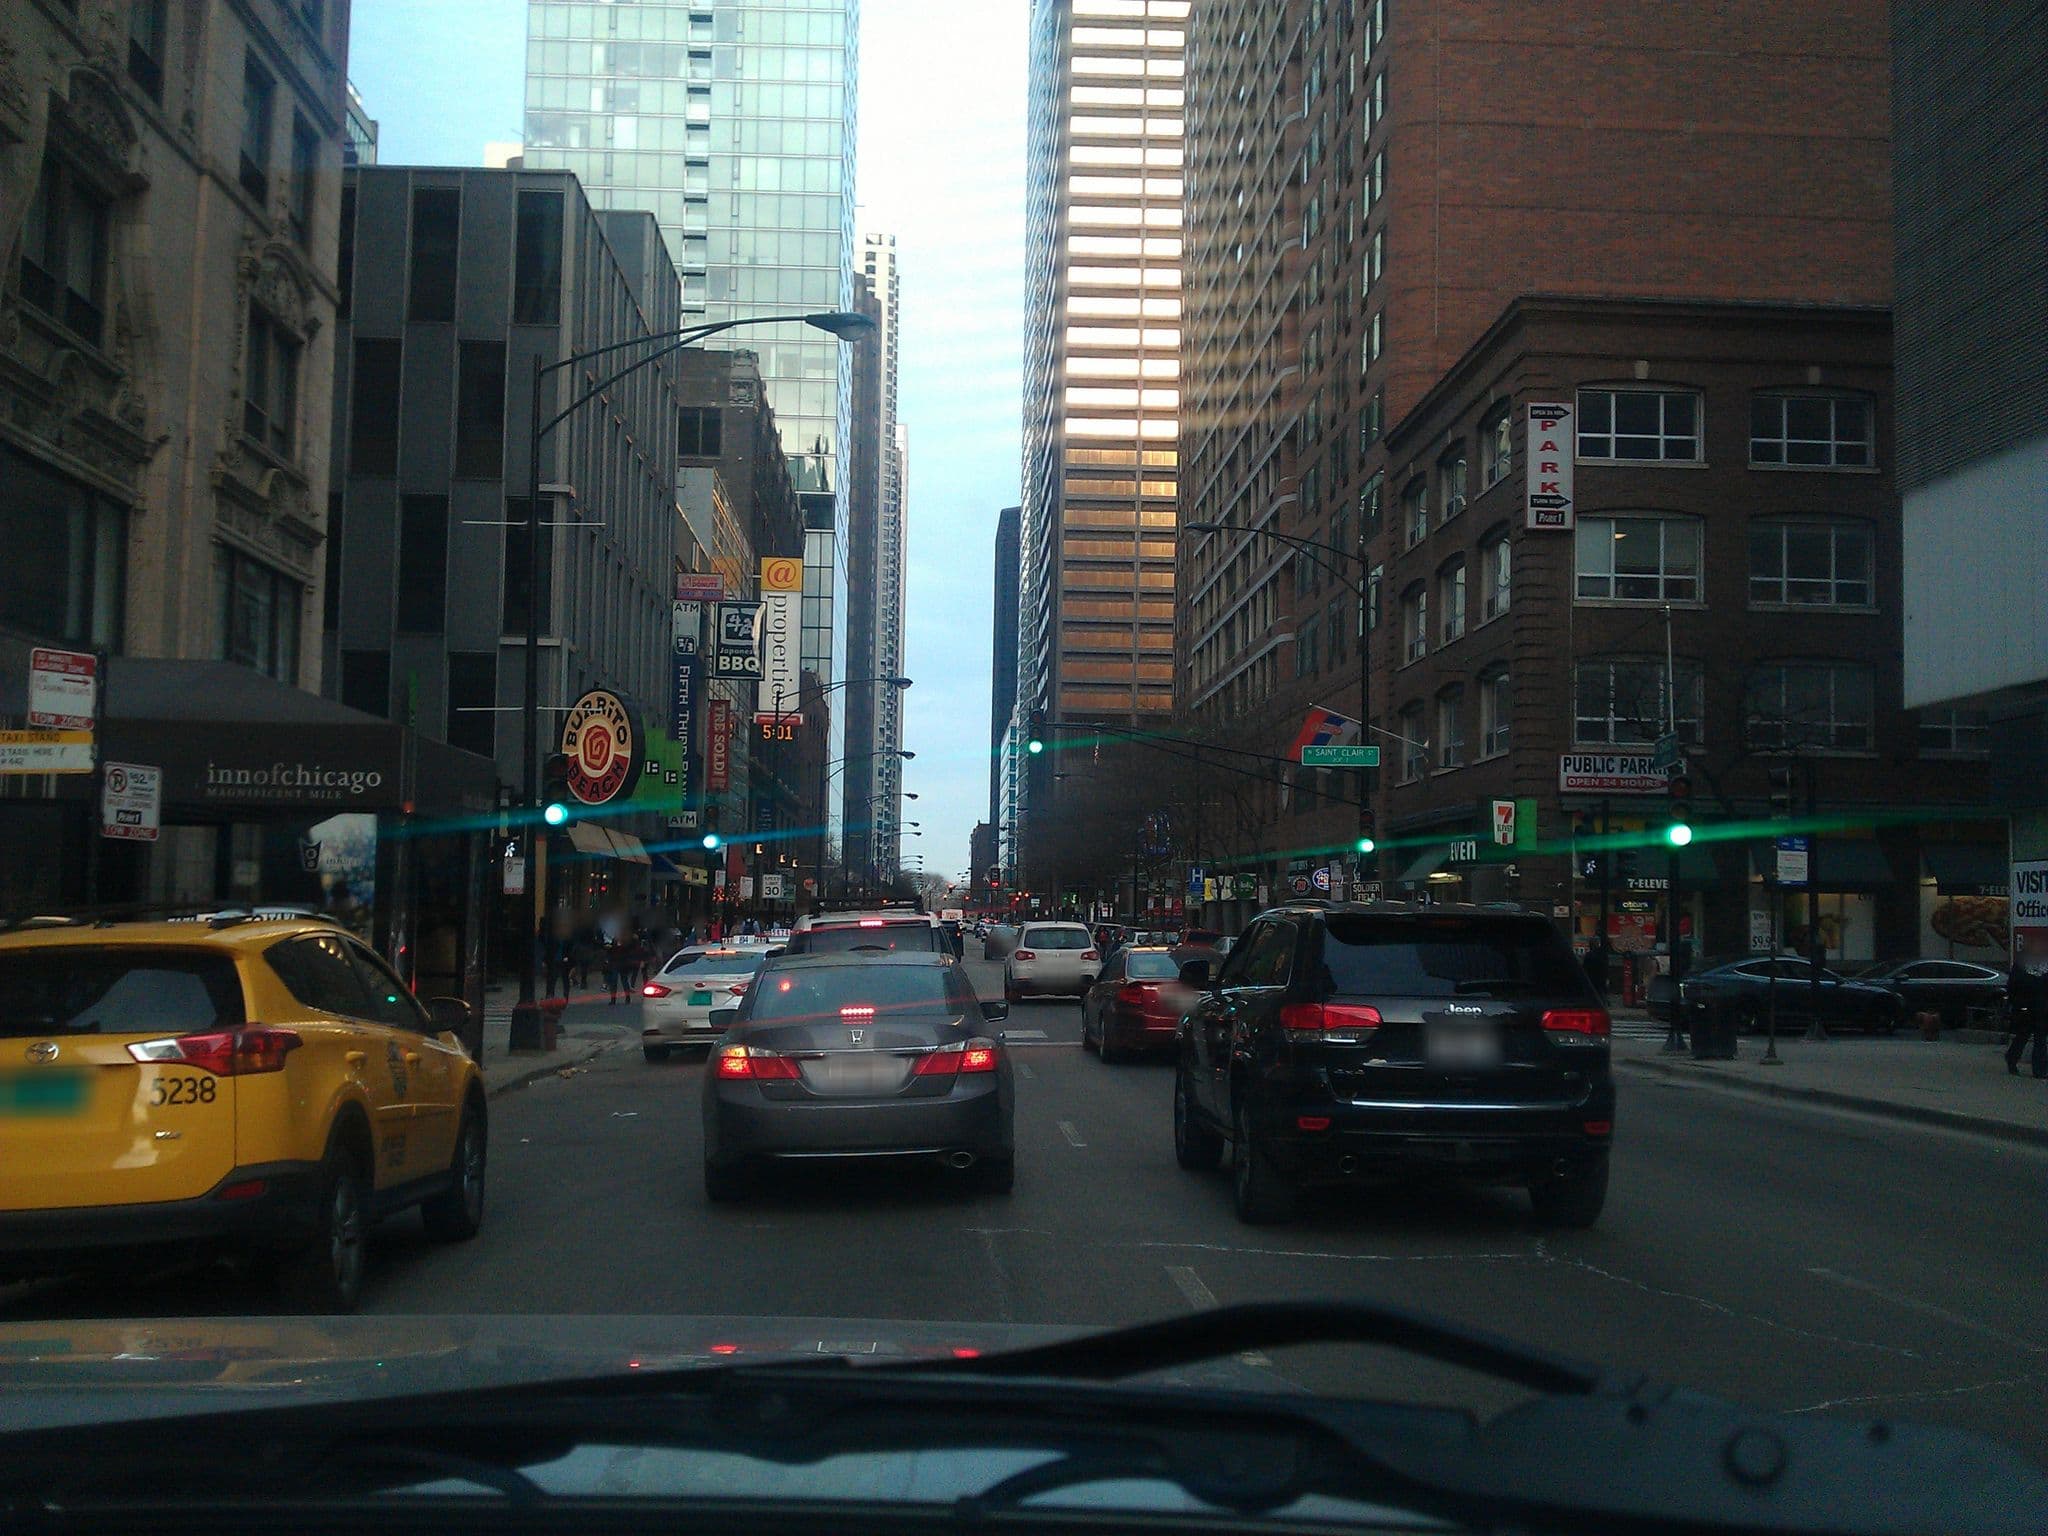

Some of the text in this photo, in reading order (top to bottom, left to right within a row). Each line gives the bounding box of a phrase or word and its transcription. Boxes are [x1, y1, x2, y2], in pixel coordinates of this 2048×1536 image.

[1539, 420, 1559, 493] PARK
[767, 559, 797, 589] @
[675, 602, 699, 612] ATM
[719, 655, 761, 672] BBQ
[678, 665, 691, 704] FIFTH
[34, 712, 88, 728] TOW ZONE
[566, 696, 627, 746] BURRITO
[713, 704, 725, 776] TRE SOLDI
[763, 724, 793, 740] 5:01
[1341, 749, 1364, 757] CLAIR
[1563, 757, 1669, 775] PUBLIC PARK
[207, 761, 382, 793] innofchicago
[568, 761, 625, 799] BEACH
[1567, 777, 1662, 787] OPEN 24 HOURS
[207, 788, 344, 800] MAGNIFICENT MILE
[671, 815, 695, 825] ATM
[1498, 806, 1512, 824] 7
[1192, 868, 1203, 883] H
[1627, 878, 1671, 889] 7-ELEVE
[765, 886, 779, 896] 30
[1352, 883, 1380, 892] SOLDIER
[2016, 899, 2048, 918] Offic
[1444, 1003, 1482, 1018] Jeep
[150, 1076, 216, 1107] 5238
